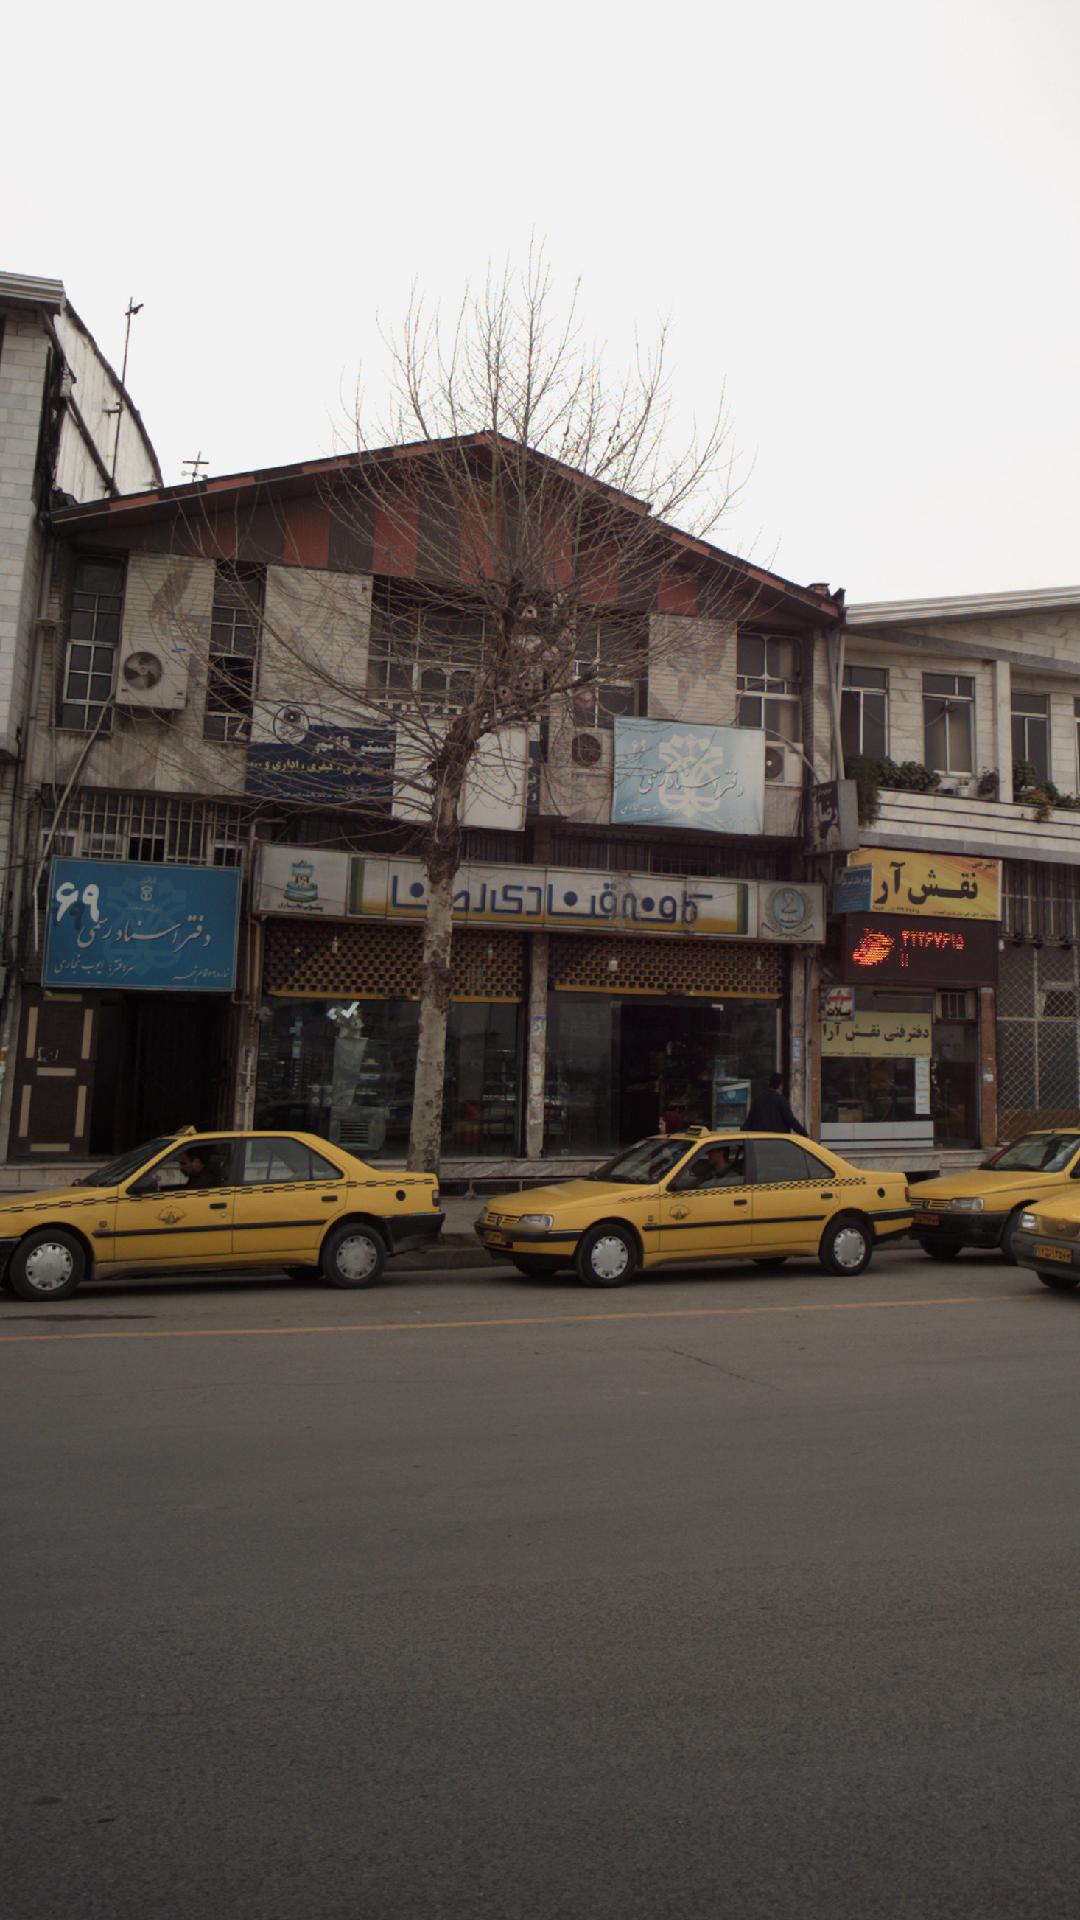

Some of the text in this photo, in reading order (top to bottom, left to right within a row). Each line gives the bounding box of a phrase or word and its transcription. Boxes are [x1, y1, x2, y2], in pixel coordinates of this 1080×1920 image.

[666, 771, 721, 793] اسناد
[714, 769, 745, 801] دفتر
[873, 861, 906, 905] آر
[907, 868, 979, 905] نقش
[55, 881, 100, 923] ۶۹
[75, 914, 212, 953] دفتر اسناد رسمی
[822, 1022, 930, 1043] دفتر فنی نقش آرا
